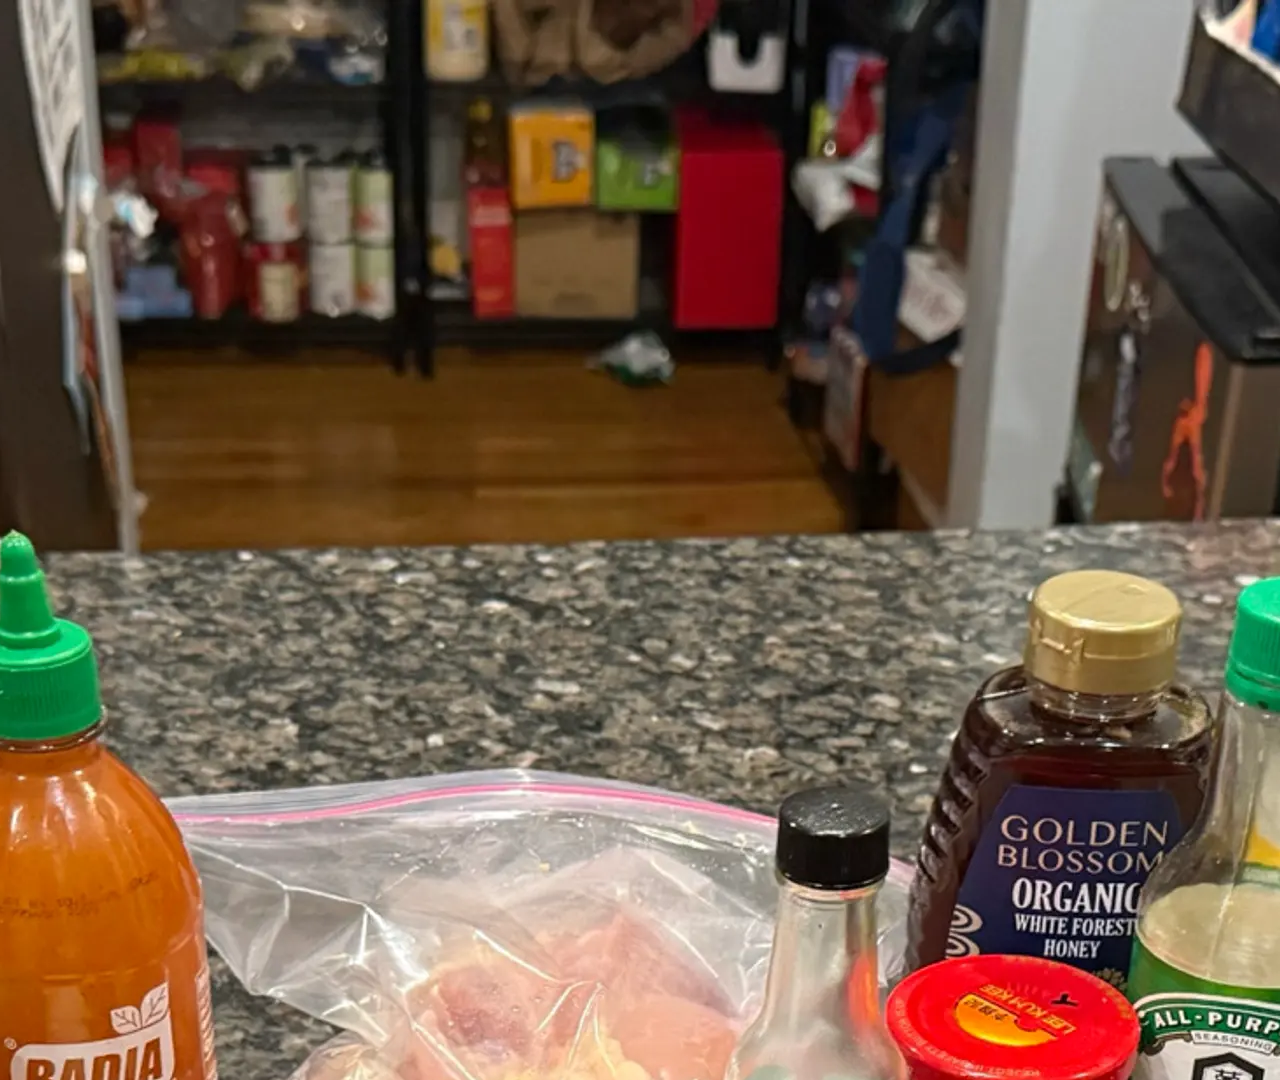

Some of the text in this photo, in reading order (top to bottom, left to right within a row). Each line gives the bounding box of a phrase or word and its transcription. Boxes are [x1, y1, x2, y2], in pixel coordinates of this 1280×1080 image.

[1001, 815, 1169, 847] GOLDEN
[997, 843, 1164, 875] BLOSSOM
[1012, 876, 1141, 914] ORGANIC
[1015, 912, 1137, 937] WHITE FOREST
[1043, 938, 1101, 959] HONEY
[978, 982, 1013, 1000] KEE
[1009, 993, 1047, 1018] KUM
[1042, 1014, 1076, 1035] LEE
[1194, 1032, 1273, 1051] SEASONING
